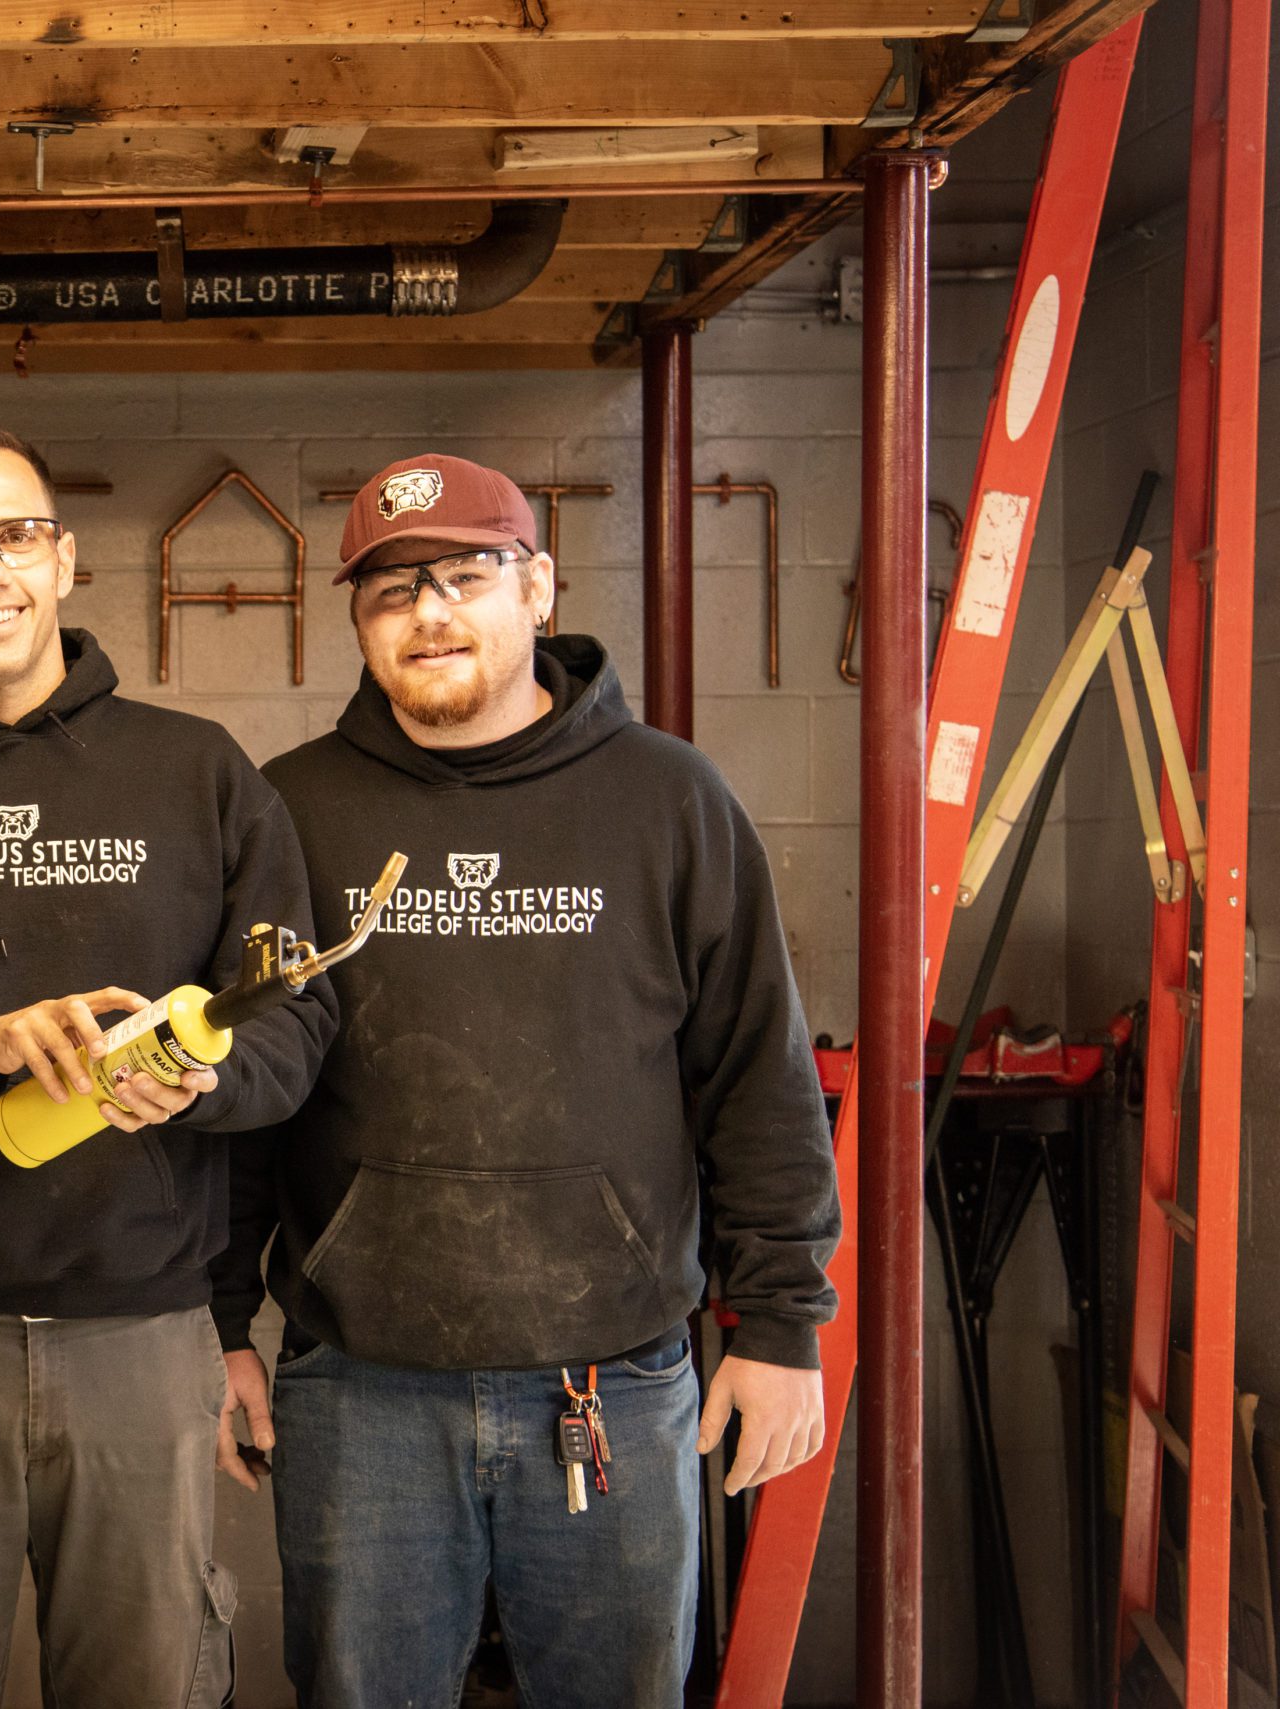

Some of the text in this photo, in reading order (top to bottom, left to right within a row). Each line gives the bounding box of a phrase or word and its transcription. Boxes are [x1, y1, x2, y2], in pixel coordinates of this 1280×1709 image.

[55, 280, 120, 309] USA
[145, 273, 344, 306] CARLOTTE
[32, 838, 148, 866] STEVENS
[10, 862, 140, 888] TECHNOLOGY
[490, 887, 604, 913] STEVENS
[350, 913, 596, 937] CLLEGE OF TECHNOLOGY
